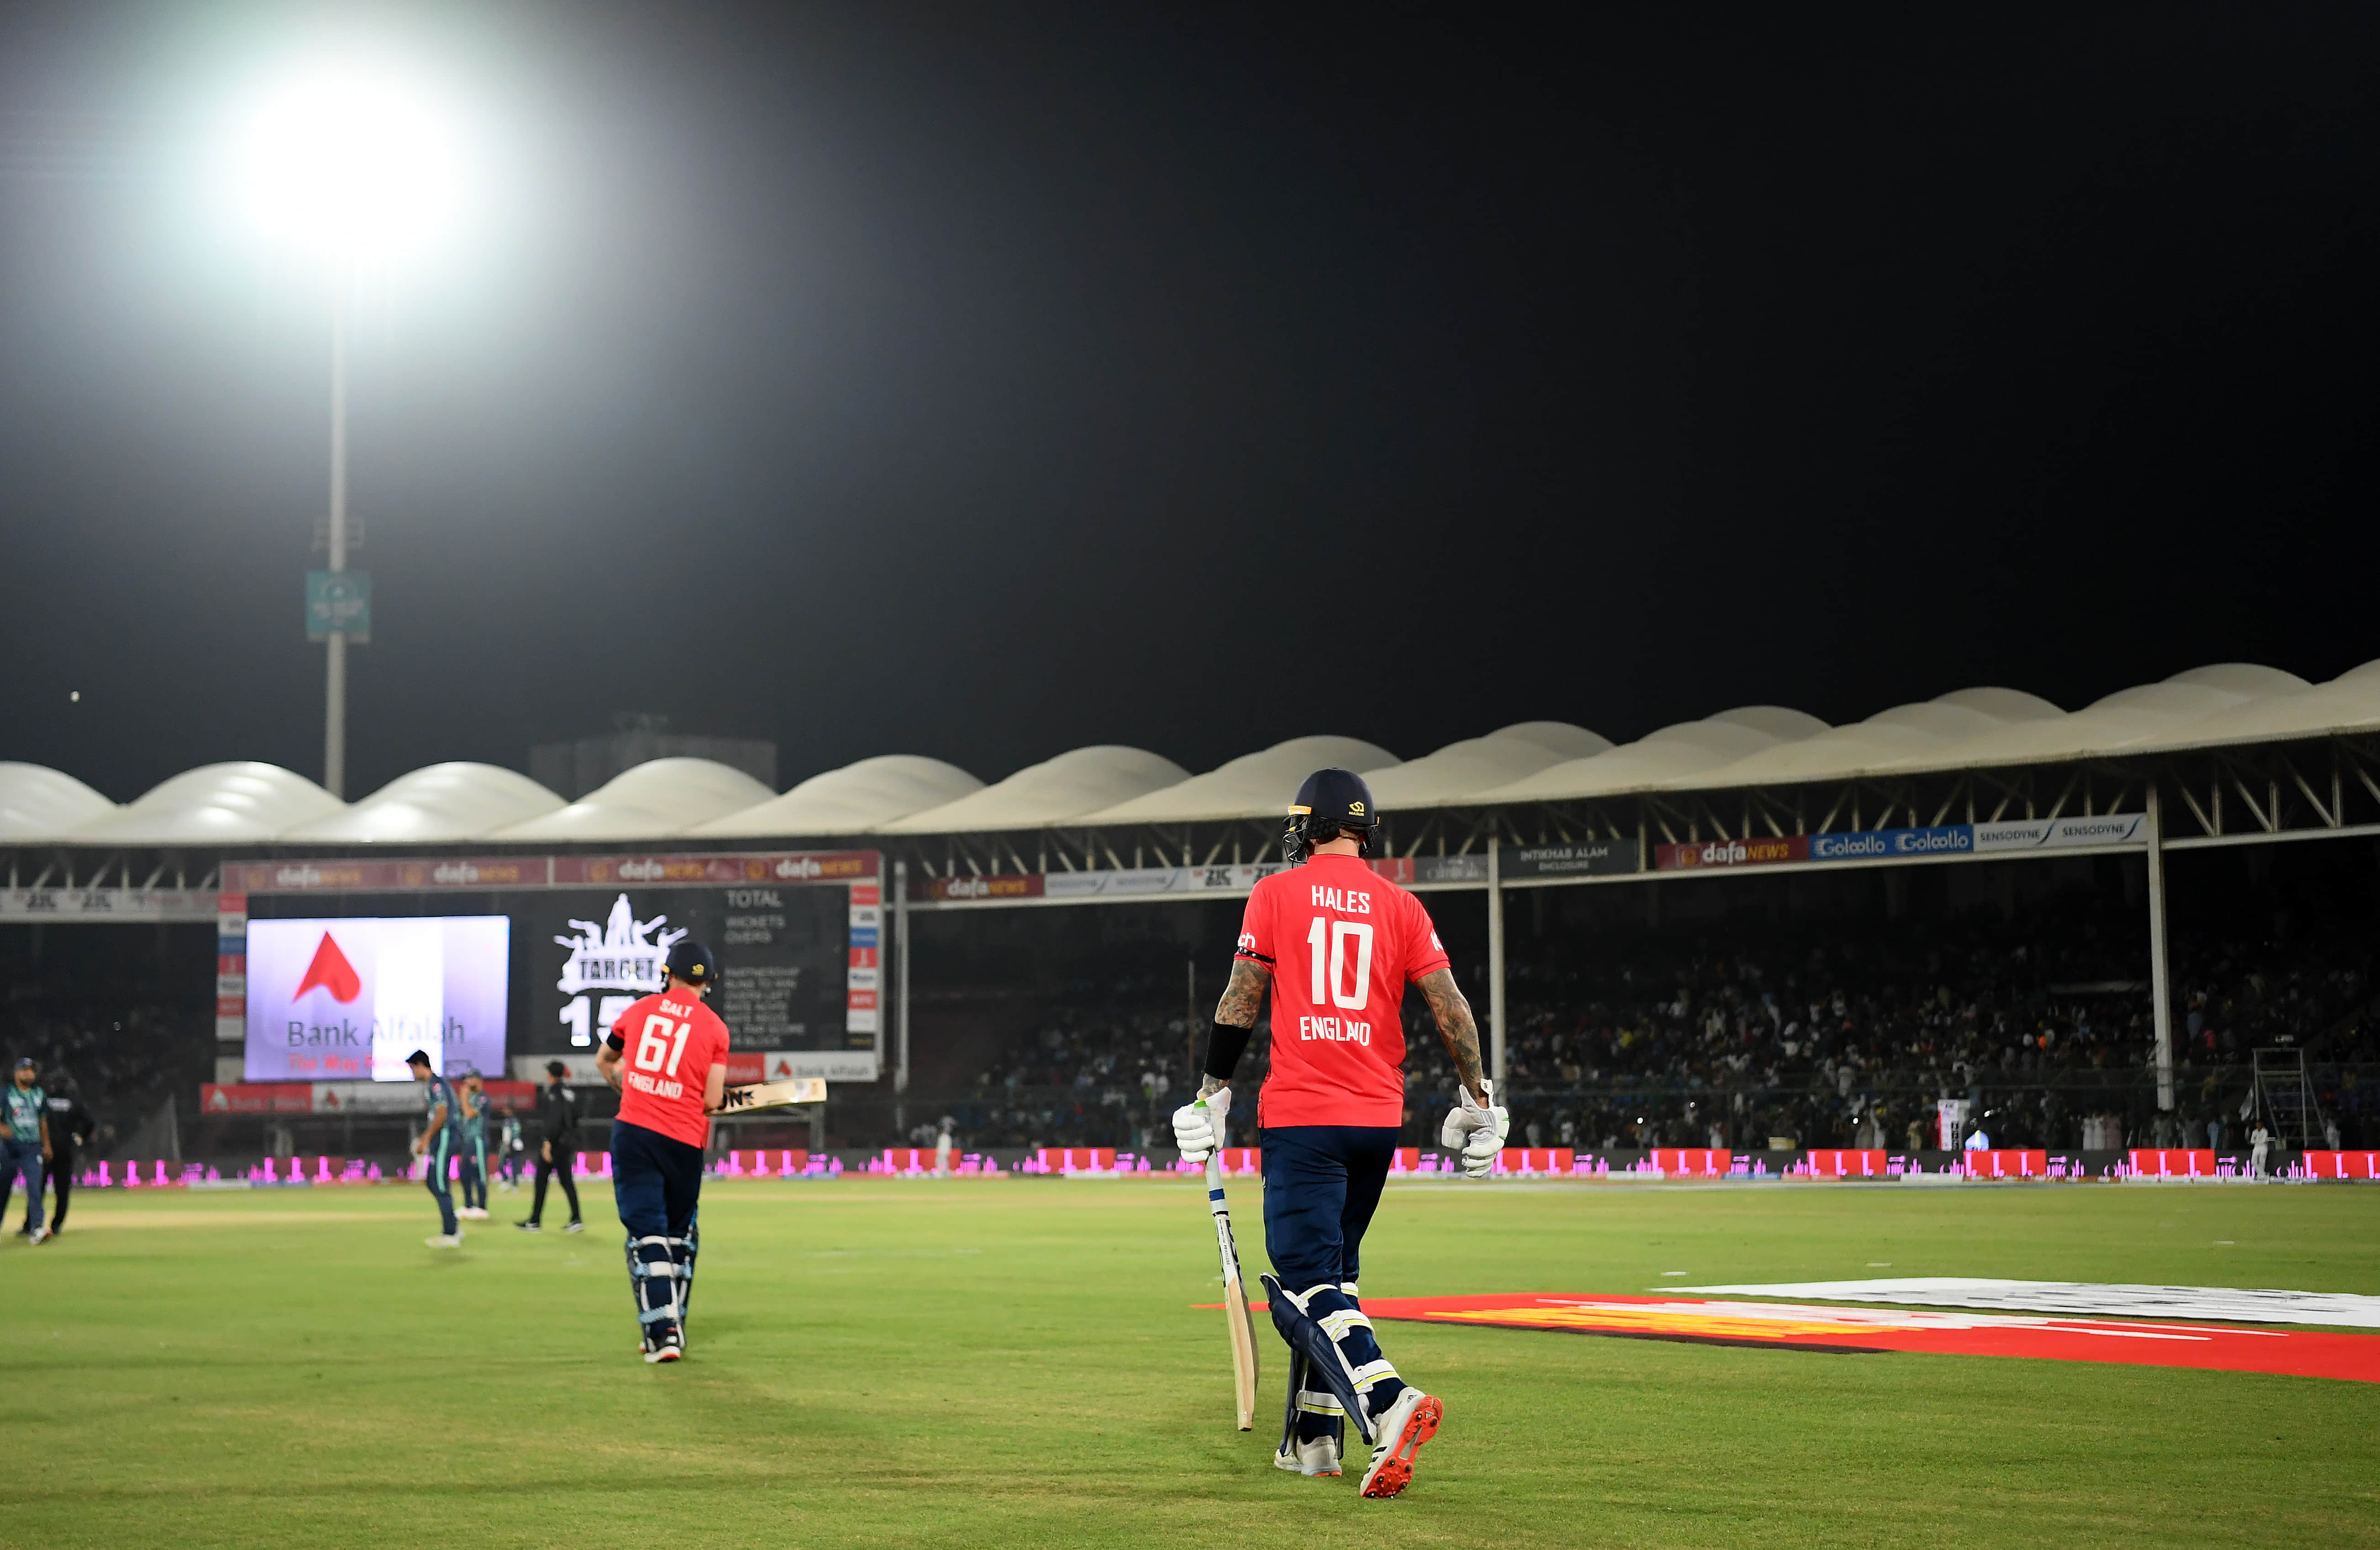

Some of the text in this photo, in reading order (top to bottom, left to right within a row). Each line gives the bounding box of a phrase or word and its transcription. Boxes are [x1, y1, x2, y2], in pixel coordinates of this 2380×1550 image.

[1980, 828, 2040, 842] SENSODYNE
[2062, 823, 2125, 837] SENSODYNE
[1576, 846, 1608, 858] ALAM
[727, 889, 783, 908] TOTAL
[1311, 885, 1370, 914] HALES
[580, 959, 654, 980] TARGET
[1307, 917, 1374, 1011] 10
[659, 999, 694, 1018] SALT
[288, 1017, 464, 1047] Bank Alfalah
[635, 1014, 691, 1078] 61
